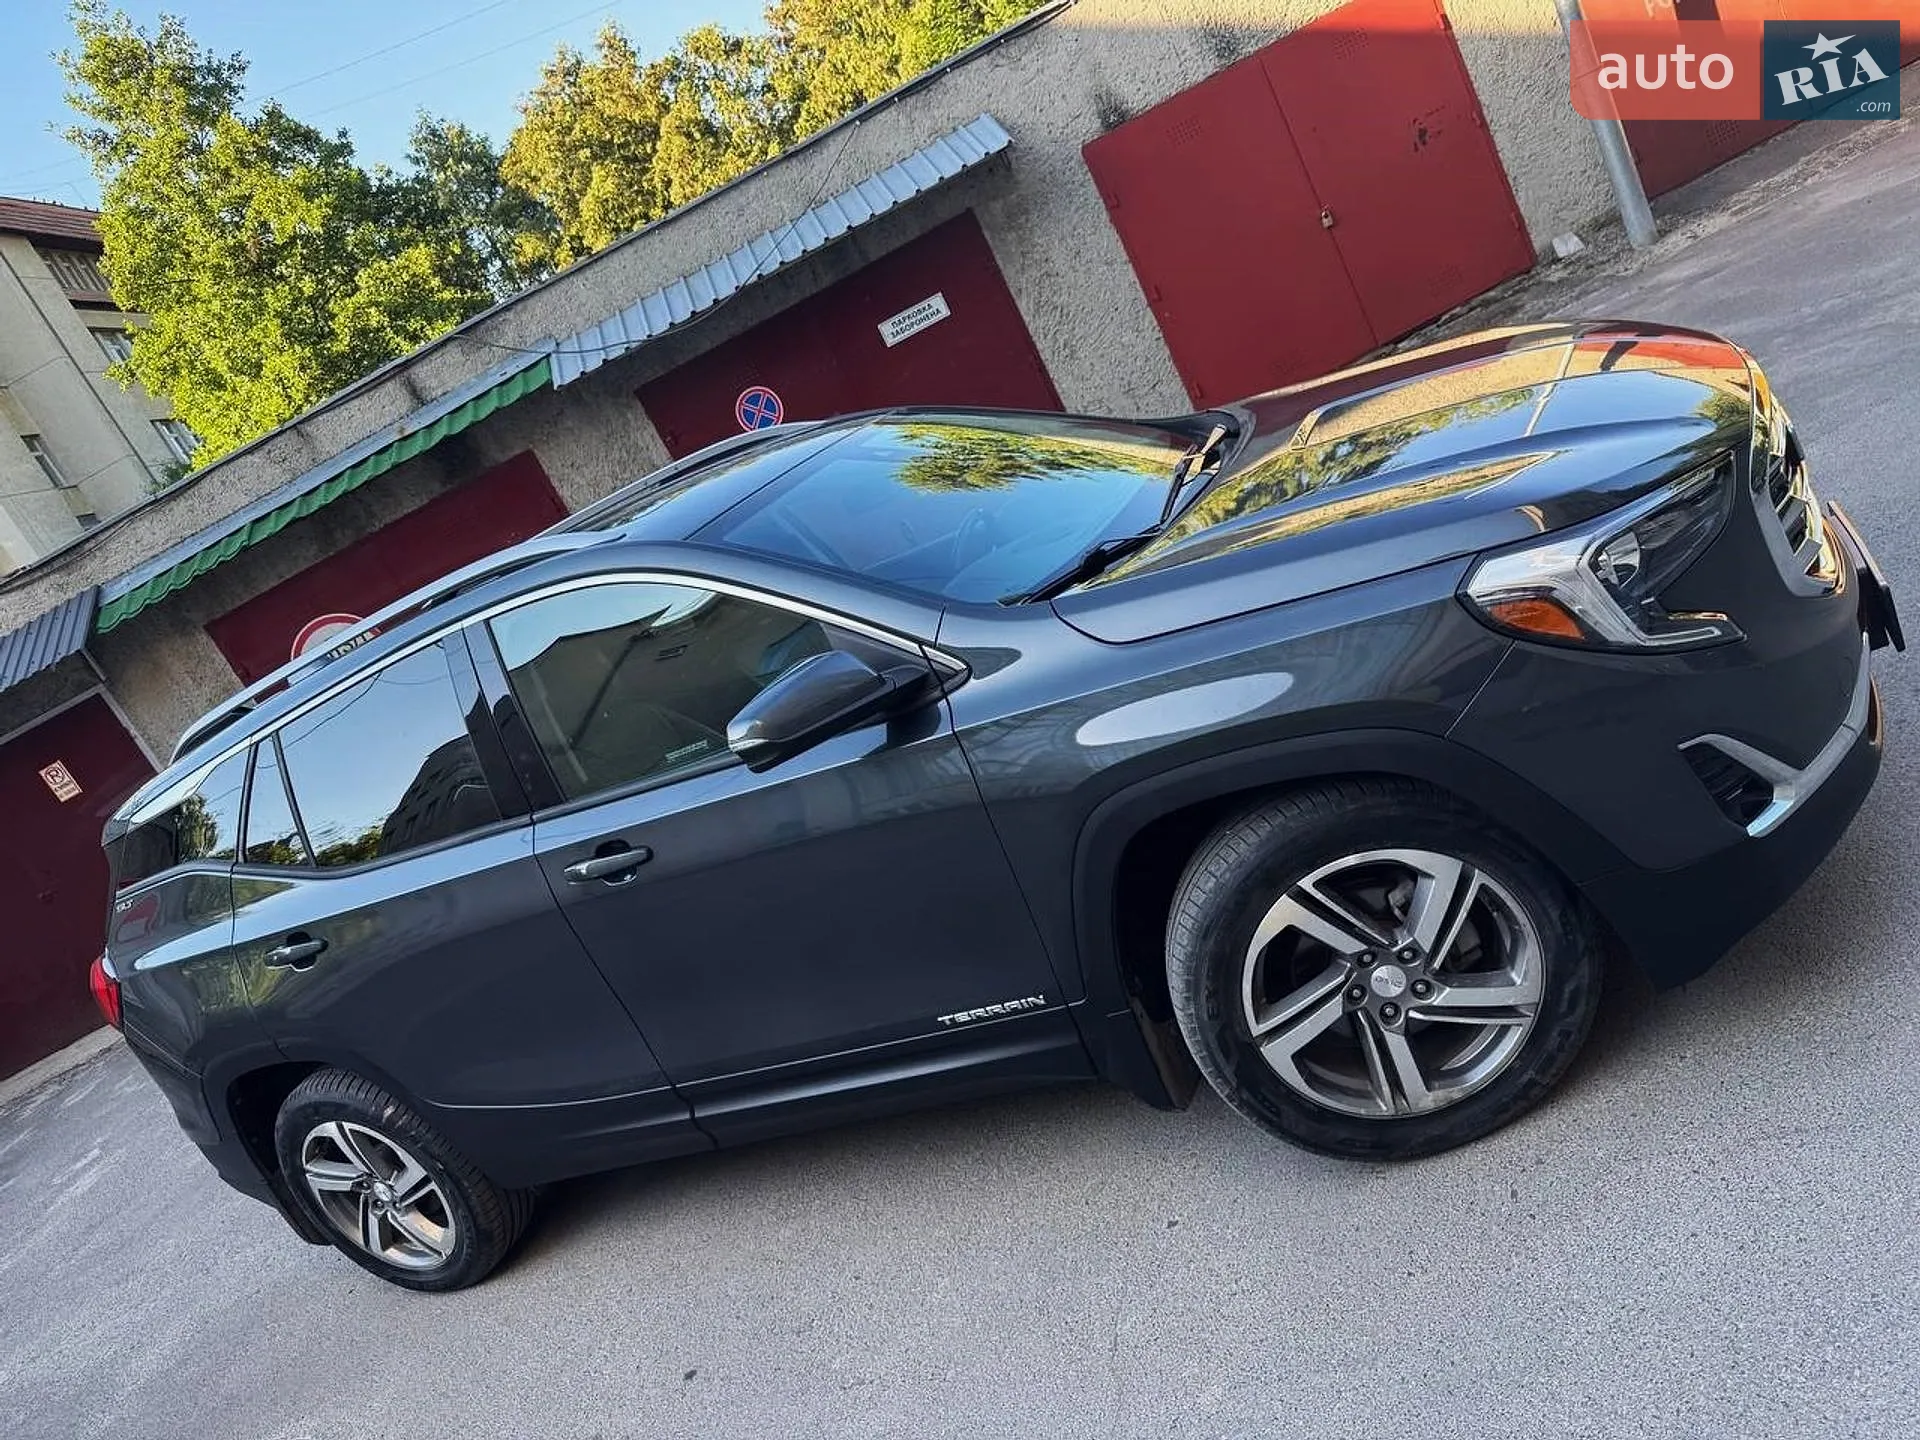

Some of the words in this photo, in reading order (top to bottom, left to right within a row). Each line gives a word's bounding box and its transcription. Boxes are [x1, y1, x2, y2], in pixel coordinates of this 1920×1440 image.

[890, 308, 942, 339] ЗАБОРОНЕНА
[891, 303, 933, 329] ПАРКОВКА
[937, 994, 1046, 1025] TERRAIN
